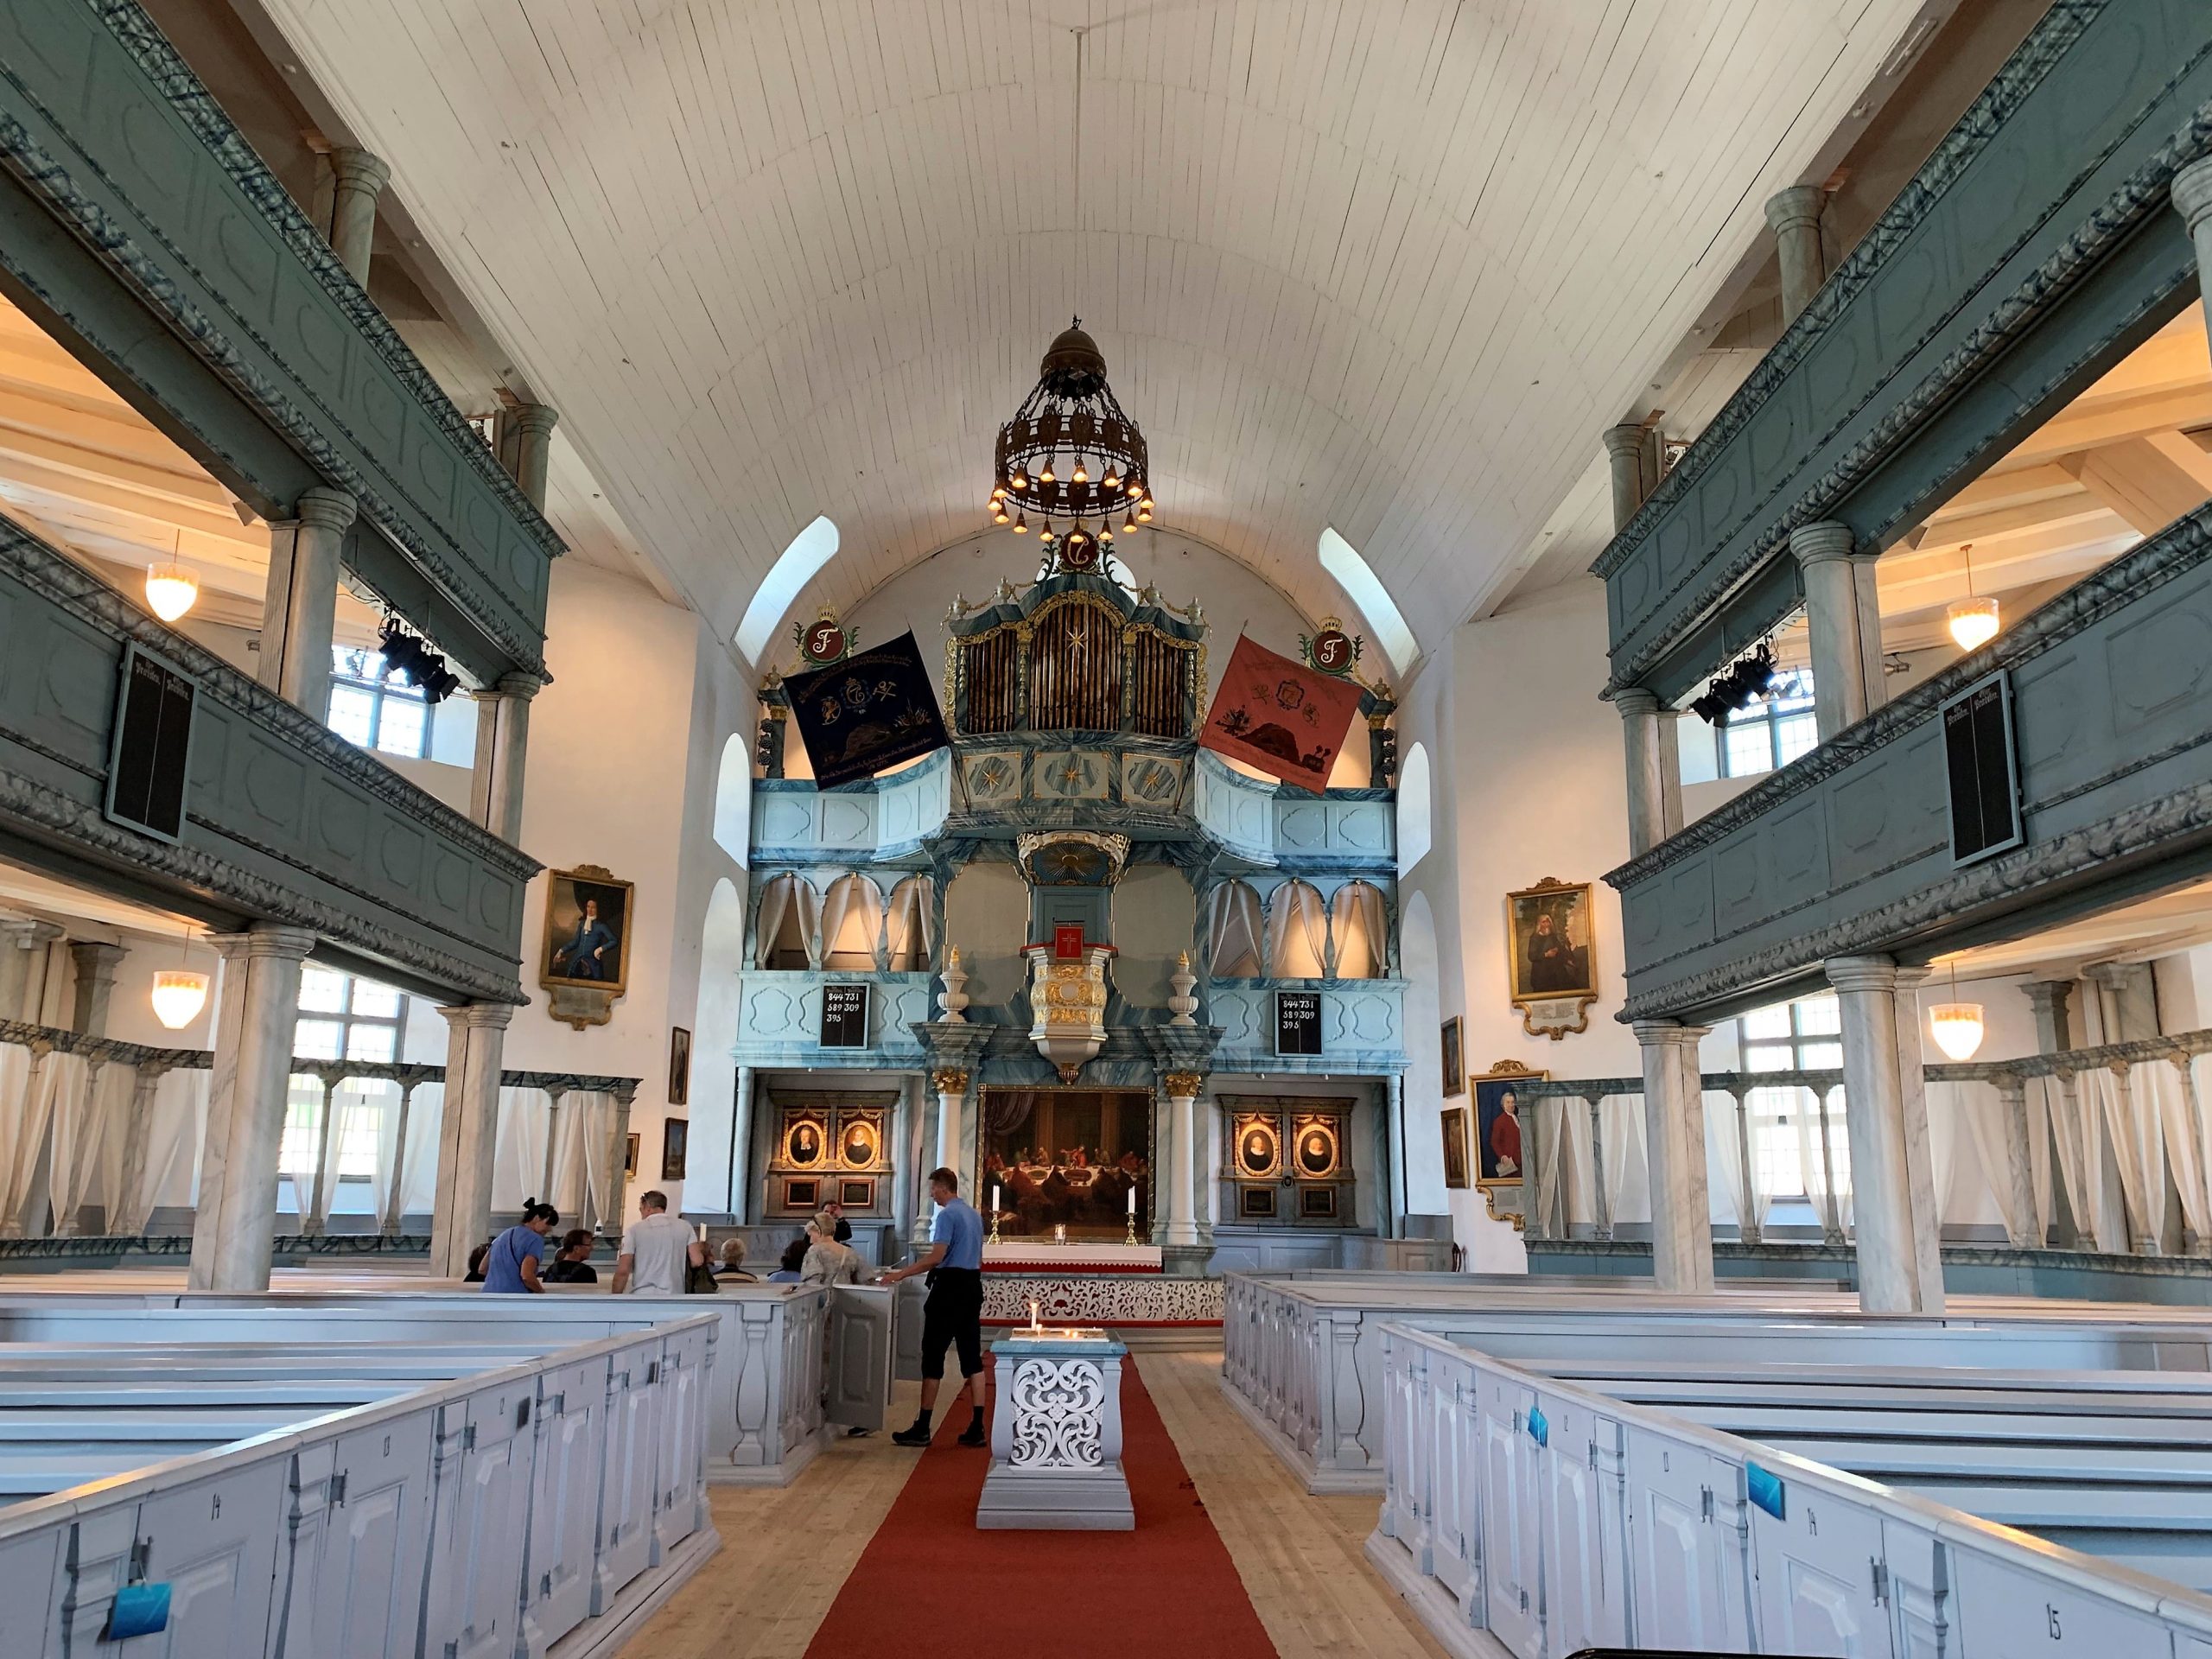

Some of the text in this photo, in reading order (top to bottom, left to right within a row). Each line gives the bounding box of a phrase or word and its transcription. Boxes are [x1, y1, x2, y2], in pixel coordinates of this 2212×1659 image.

[828, 993, 843, 1001] 844
[844, 993, 859, 1001] 731
[843, 1003, 860, 1012] 309
[1283, 1000, 1298, 1008] 844
[1299, 1000, 1313, 1008] 731
[211, 1492, 221, 1521] 14
[2046, 1603, 2061, 1640] 15
